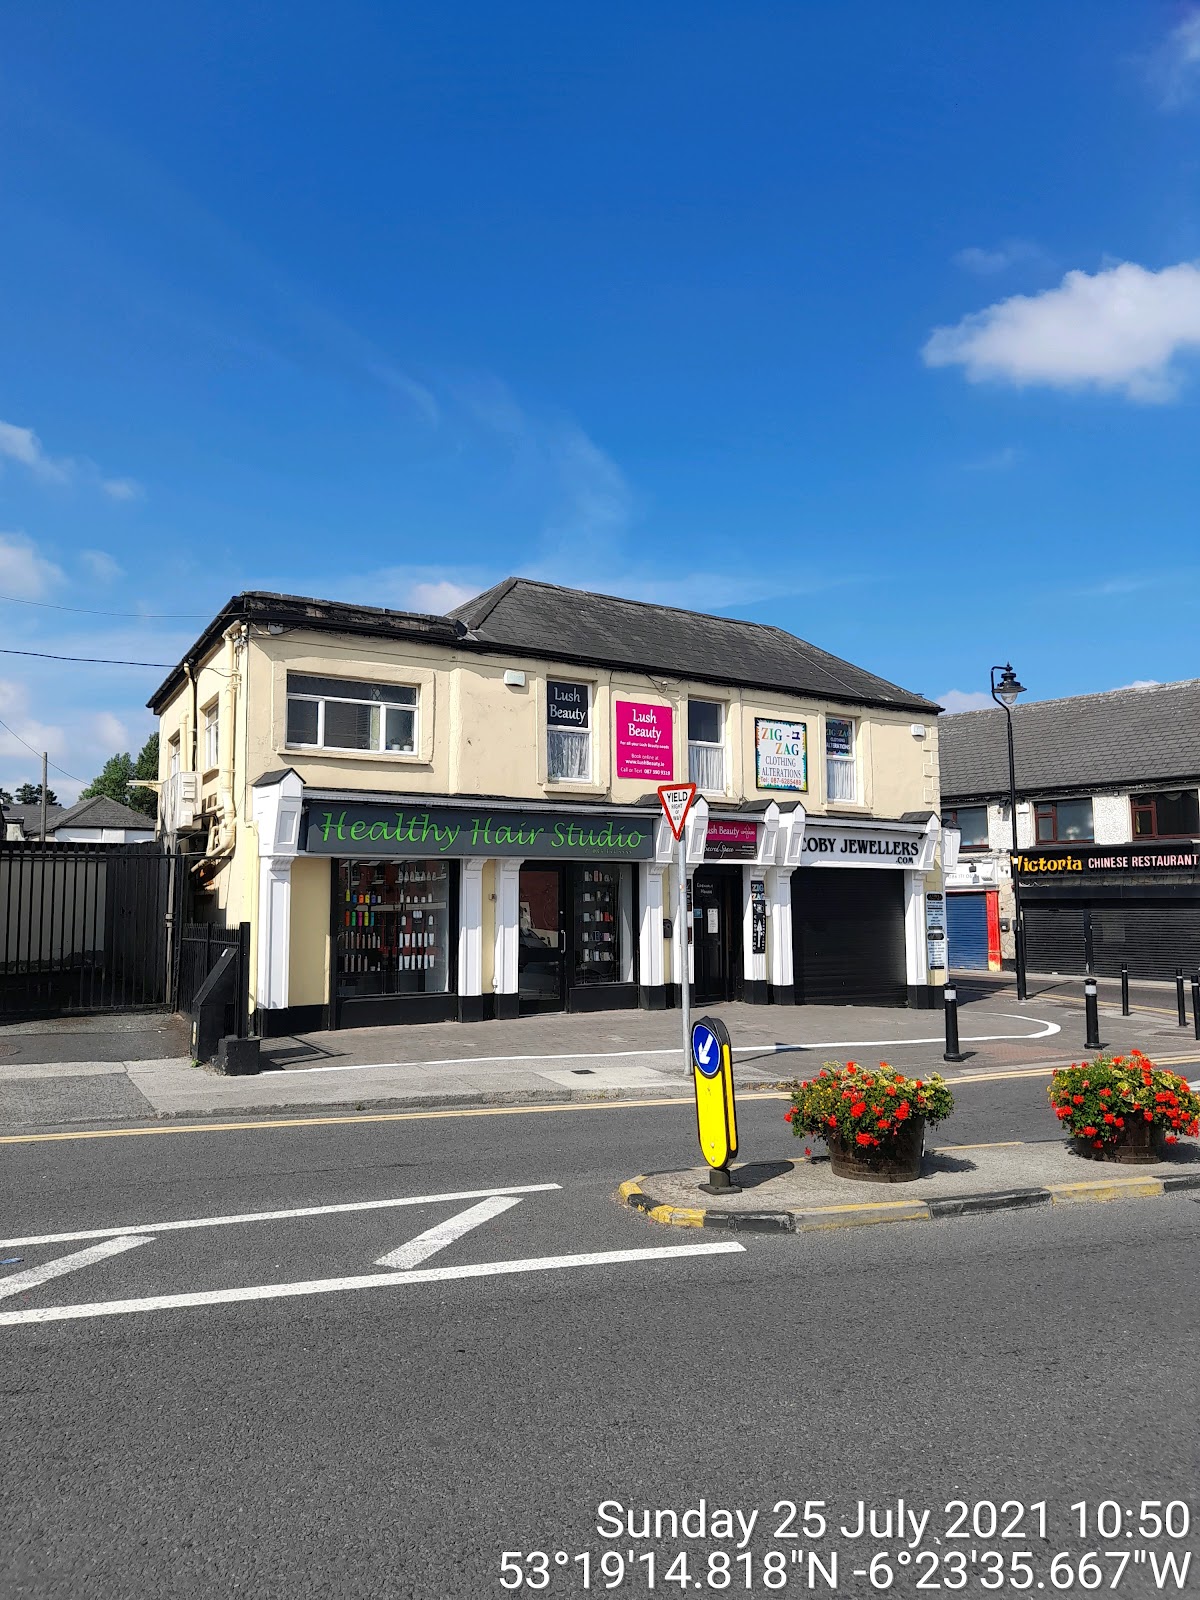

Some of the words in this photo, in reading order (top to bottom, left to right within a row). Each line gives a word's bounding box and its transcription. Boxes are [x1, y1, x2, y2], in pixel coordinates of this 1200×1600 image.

[554, 687, 581, 702] Lush
[549, 704, 586, 724] Beauty
[632, 709, 657, 724] Lush
[628, 723, 661, 743] Beauty
[761, 728, 782, 741] ZIG
[776, 743, 799, 756] ZAG
[765, 755, 796, 767] CLOTHING
[762, 767, 801, 778] ALTERATIONS
[667, 791, 688, 802] YIELD
[321, 811, 461, 851] Healthy
[470, 816, 544, 846] Hair
[551, 821, 647, 849] Studio
[707, 824, 718, 834] ush
[718, 826, 740, 838] Beauty
[840, 839, 919, 856] JEWELLERS
[1088, 856, 1128, 869] CHINESE
[1131, 854, 1200, 867] RESTAURANT
